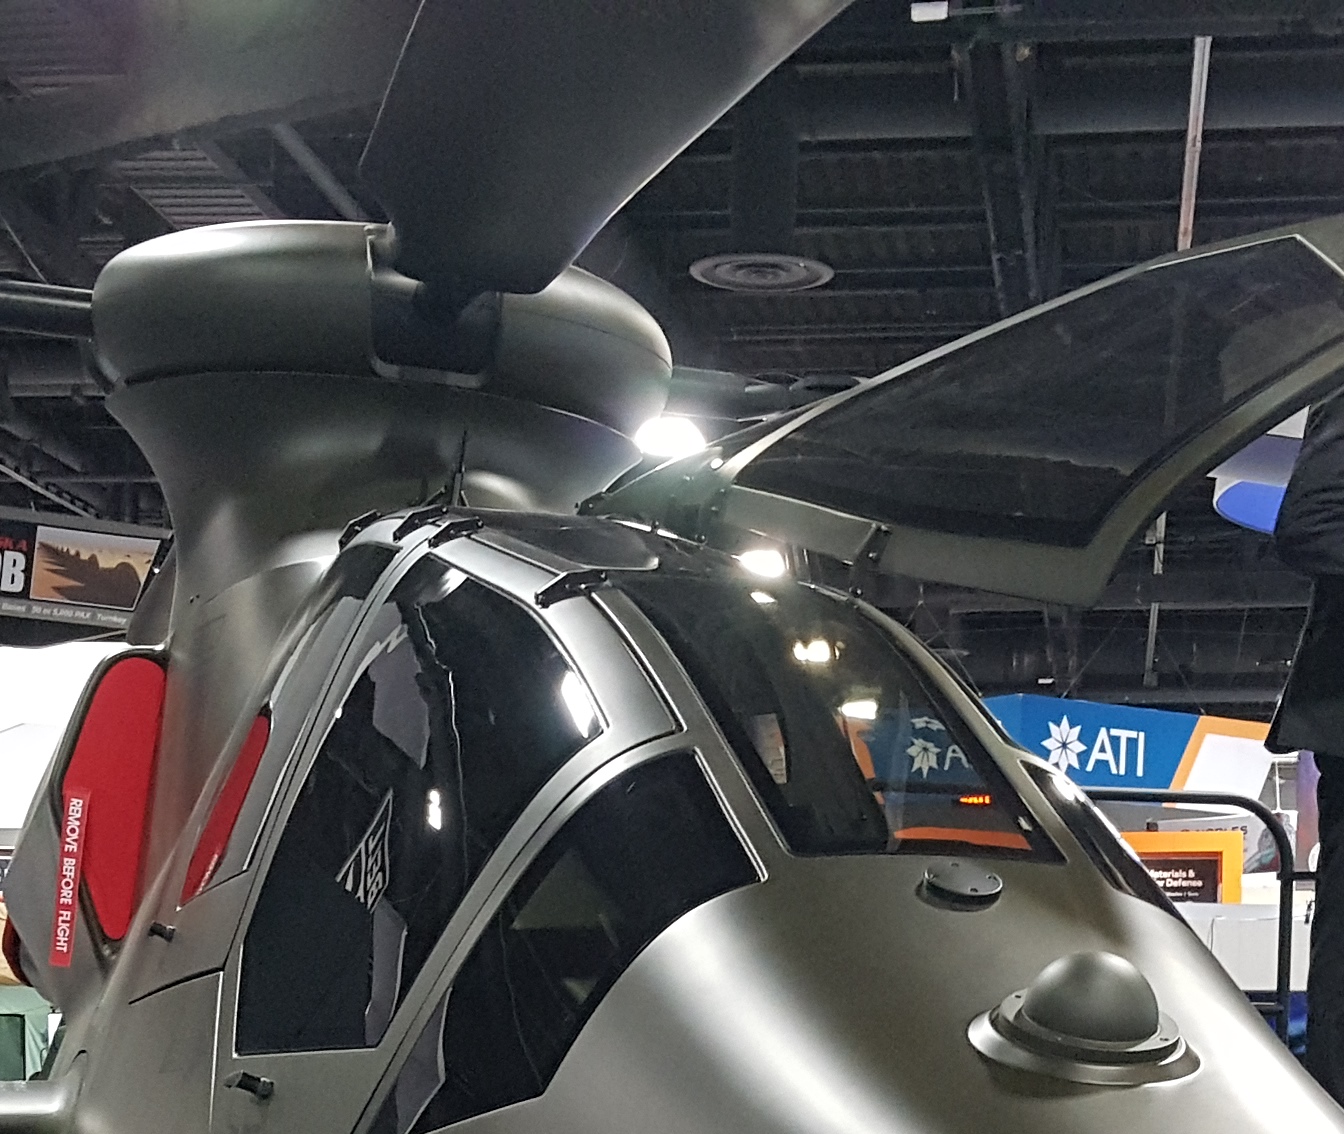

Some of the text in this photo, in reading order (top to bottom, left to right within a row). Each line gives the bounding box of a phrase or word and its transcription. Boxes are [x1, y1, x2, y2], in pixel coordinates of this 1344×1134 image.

[1085, 726, 1145, 777] ATI
[55, 798, 83, 953] REMOVE BEFORE FLIGHT
[1165, 878, 1203, 887] Defense
